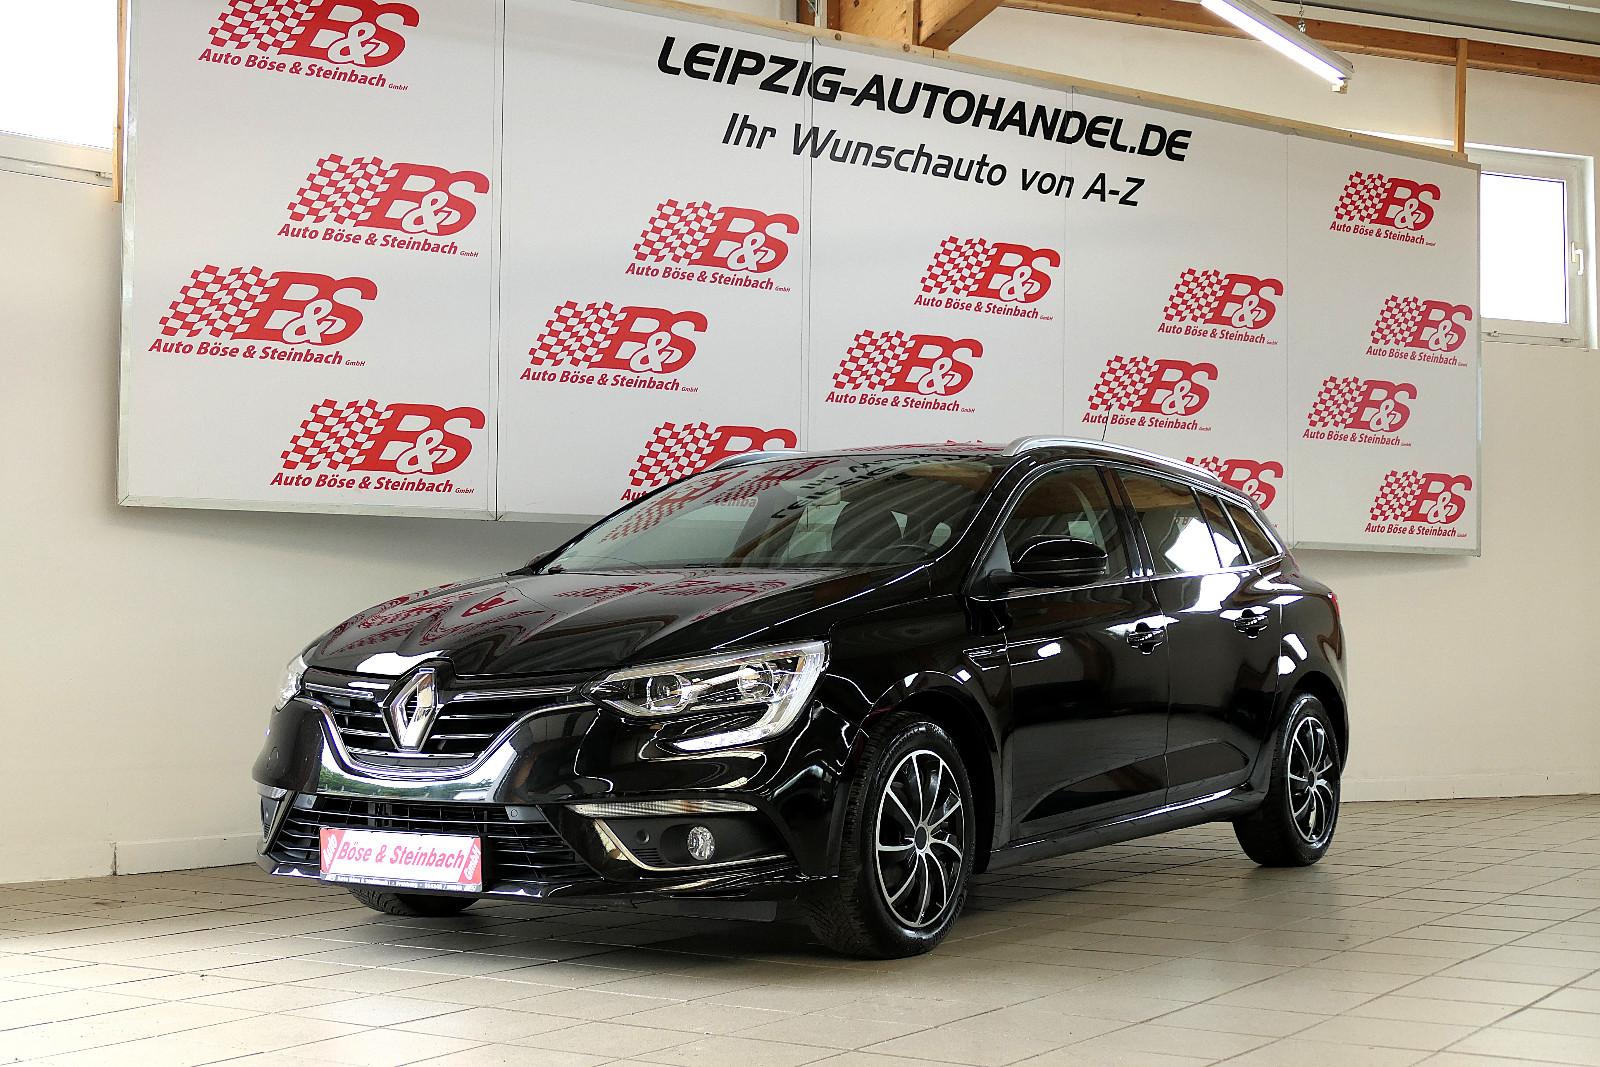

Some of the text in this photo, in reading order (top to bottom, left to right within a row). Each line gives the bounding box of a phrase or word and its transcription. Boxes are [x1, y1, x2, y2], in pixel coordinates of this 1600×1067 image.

[278, 0, 420, 67] B&S
[198, 48, 409, 91] Auto Böse & Steinbach GmbH
[657, 36, 1192, 162] LEIPZIG-AUTOHANDEL.DE
[721, 113, 1145, 206] Ihr Wunschauto von A-Z
[355, 162, 490, 236] B&S
[1370, 177, 1441, 231] B&S
[277, 224, 479, 258] Auto Böse & Steinbach GmbH
[688, 206, 800, 273] B&S
[1330, 221, 1351, 232] Auto
[1353, 225, 1374, 236] Böse
[1375, 228, 1382, 237] &
[1383, 230, 1424, 244] Steinbach
[625, 263, 791, 293] Auto Böse & Steinbach GmbH
[966, 242, 1061, 303] B&S
[231, 271, 378, 345] B&S
[914, 295, 942, 307] Auto
[945, 298, 972, 311] Böse
[974, 302, 983, 312] &
[985, 303, 1038, 319] Steinbach
[1204, 273, 1284, 329] B&S
[1405, 300, 1473, 352] B&S
[148, 339, 366, 367] Auto Böse & Steinbach GmbH
[588, 306, 708, 374] B&S
[1158, 323, 1182, 334] Auto
[1184, 325, 1208, 337] Böse
[1210, 328, 1217, 338] &
[1219, 329, 1265, 343] Steinbach
[1366, 346, 1387, 356] Auto
[1388, 348, 1408, 359] Böse
[1410, 351, 1417, 360] &
[1418, 352, 1457, 365] Steinbach
[520, 368, 556, 381] Auto
[559, 371, 594, 384] Böse
[597, 374, 609, 385] &
[611, 375, 679, 391] Steinbach
[882, 334, 984, 396] B&S
[1132, 359, 1219, 416] B&S
[825, 391, 856, 403] Auto
[859, 394, 888, 406] Böse
[891, 396, 900, 407] &
[902, 397, 959, 411] Steinbach
[1082, 413, 1108, 423] Auto
[1110, 414, 1136, 425] Böse
[1138, 416, 1146, 426] &
[1148, 417, 1198, 430] Steinbach
[1345, 380, 1418, 432] B&S
[352, 403, 486, 475] B&S
[1303, 429, 1325, 439] Auto
[1327, 431, 1348, 441] Böse
[1350, 433, 1357, 442] &
[1358, 433, 1400, 445] Steinbach
[270, 473, 312, 486] Auto
[315, 474, 355, 488] Böse
[358, 476, 372, 489] &
[374, 477, 453, 492] Steinbach
[1403, 472, 1473, 524] B&S
[1365, 523, 1385, 533] Auto
[1387, 524, 1407, 534] Böse
[1408, 525, 1415, 534] &
[1416, 526, 1456, 536] Steinbach
[337, 841, 465, 869] Böse & Steinbach
